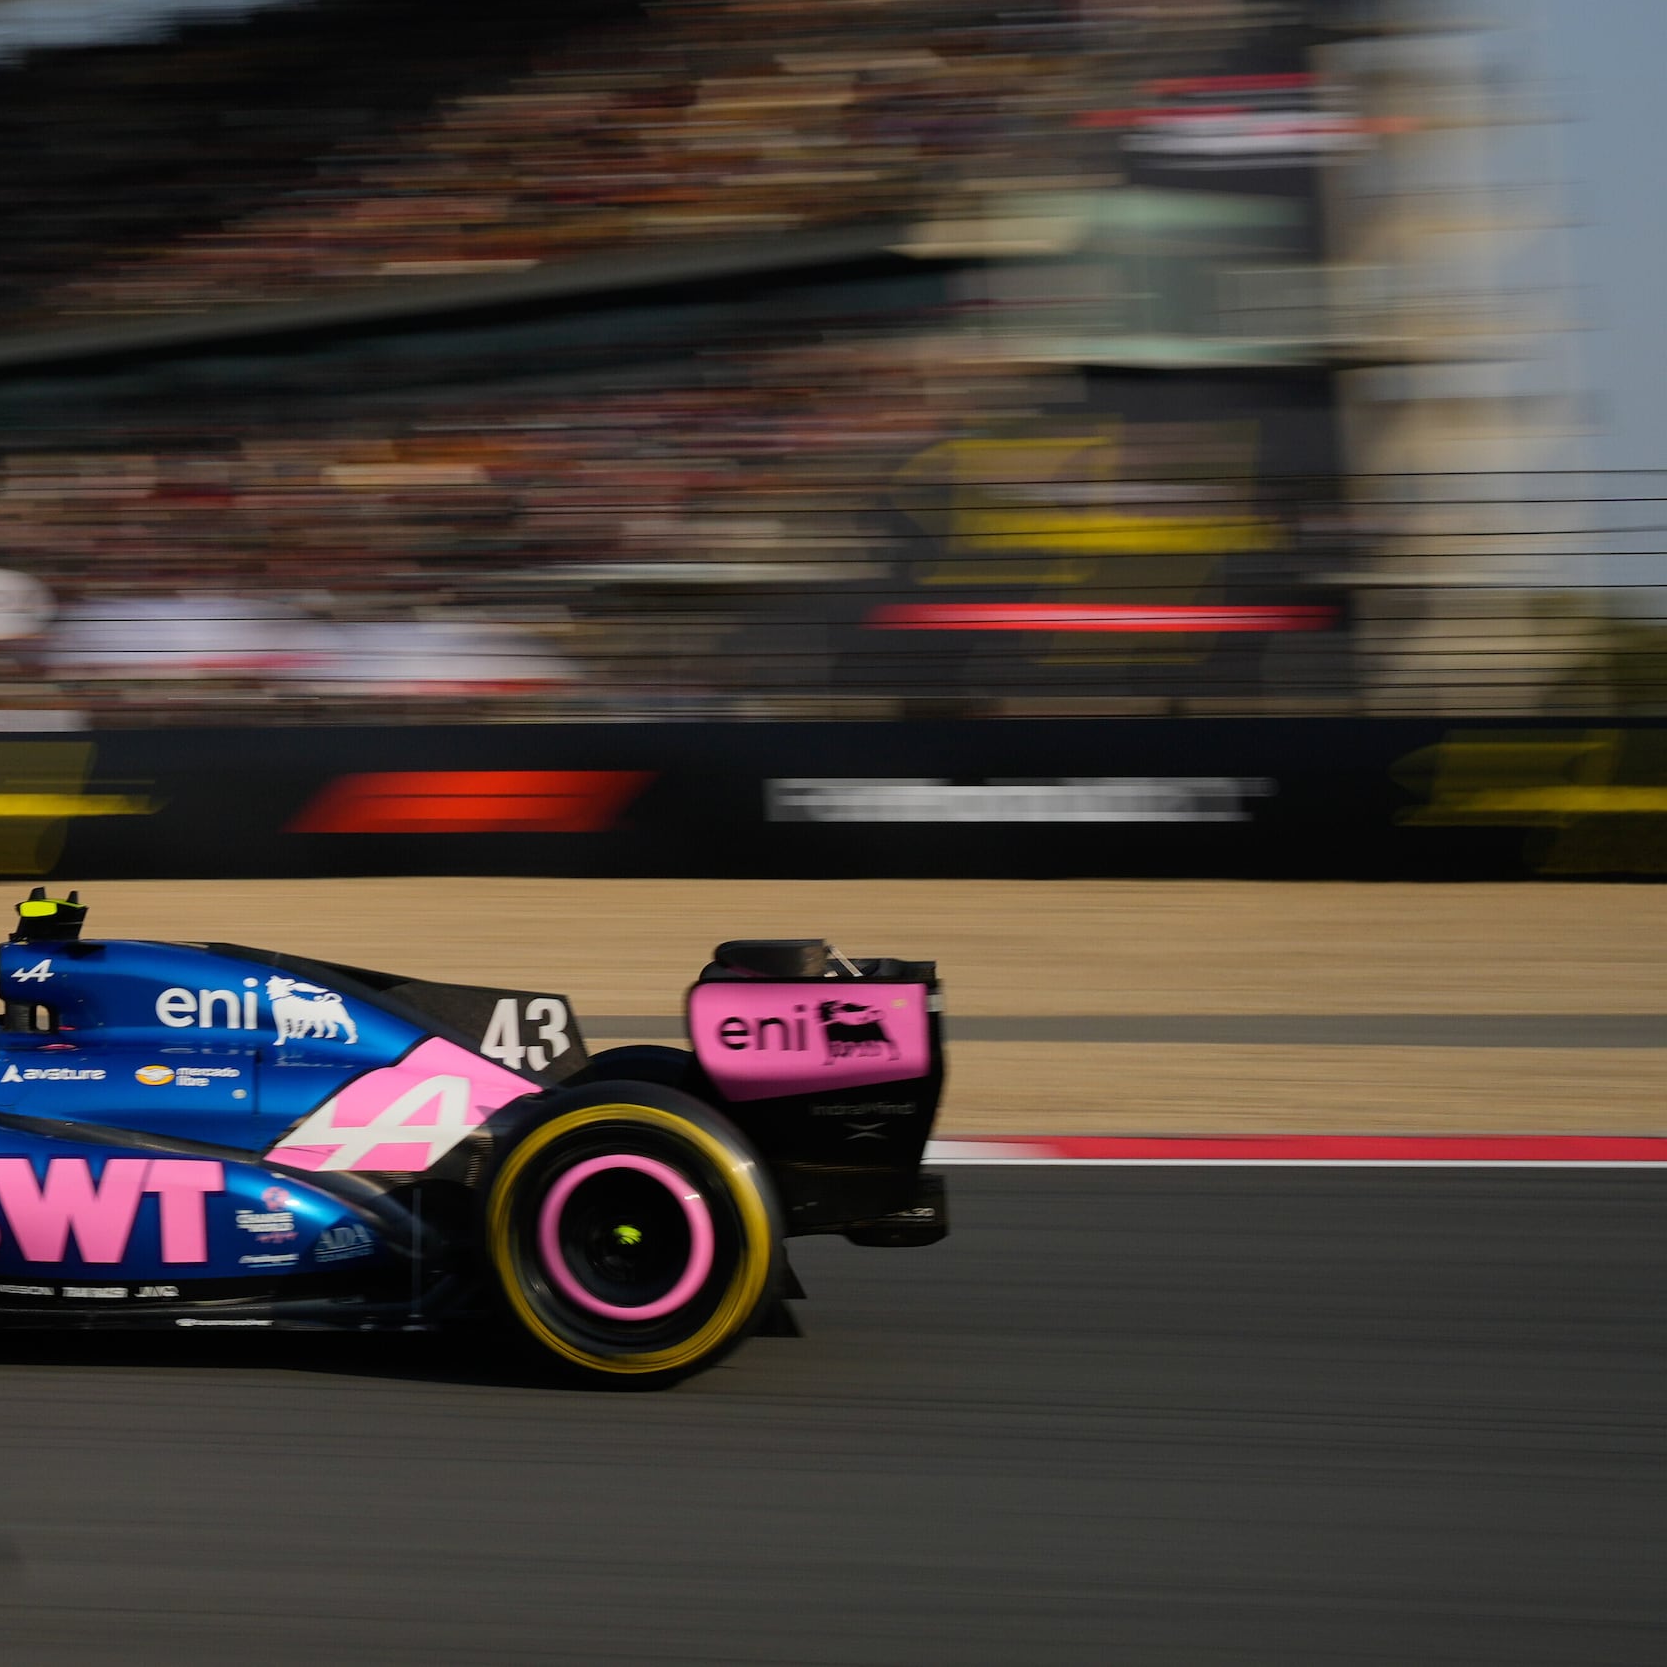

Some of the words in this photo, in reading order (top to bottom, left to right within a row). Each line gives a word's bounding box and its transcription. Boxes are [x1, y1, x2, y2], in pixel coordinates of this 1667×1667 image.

[155, 977, 257, 1030] eni
[717, 1005, 807, 1052] eni
[479, 997, 571, 1071] 43
